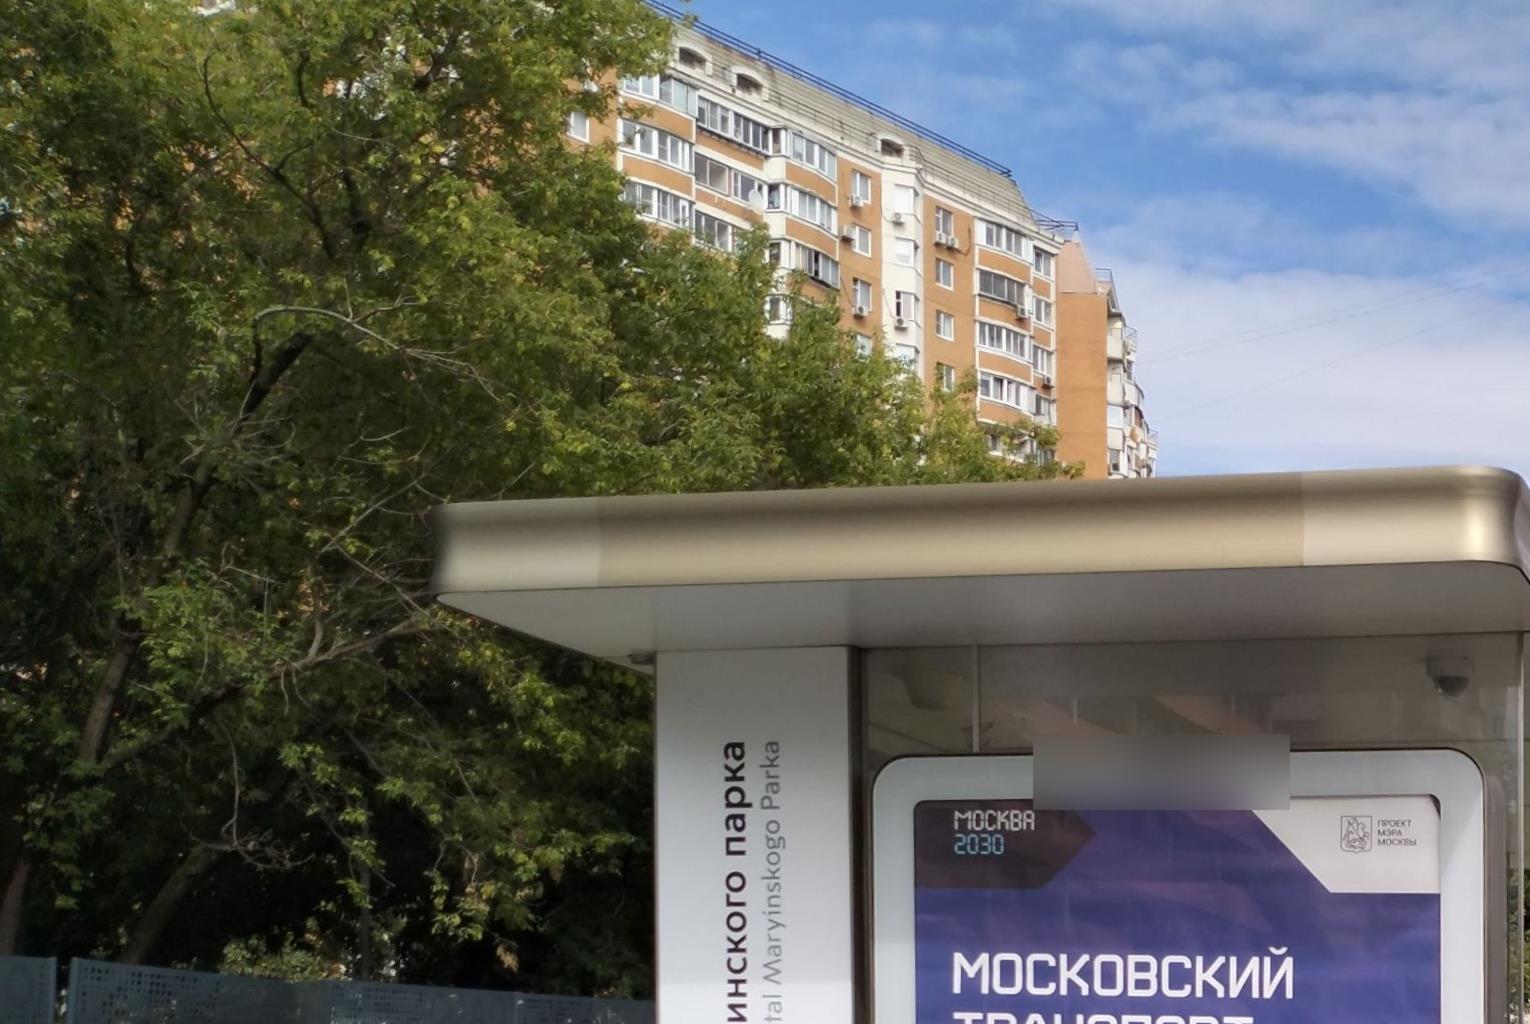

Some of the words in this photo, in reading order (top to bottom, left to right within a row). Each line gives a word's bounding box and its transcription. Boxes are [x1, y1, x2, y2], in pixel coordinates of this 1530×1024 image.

[759, 740, 781, 810] Parka
[723, 741, 753, 856] парка
[953, 809, 1036, 832] МОСКВА
[1377, 819, 1412, 828] ПРОЕКТ
[953, 833, 1005, 855] 2030
[1377, 829, 1404, 837] МЭРА
[1377, 838, 1417, 846] МОСКВЫ
[760, 819, 786, 985] Maryinskogo
[951, 945, 1295, 1000] МОСКОВСКИЙ
